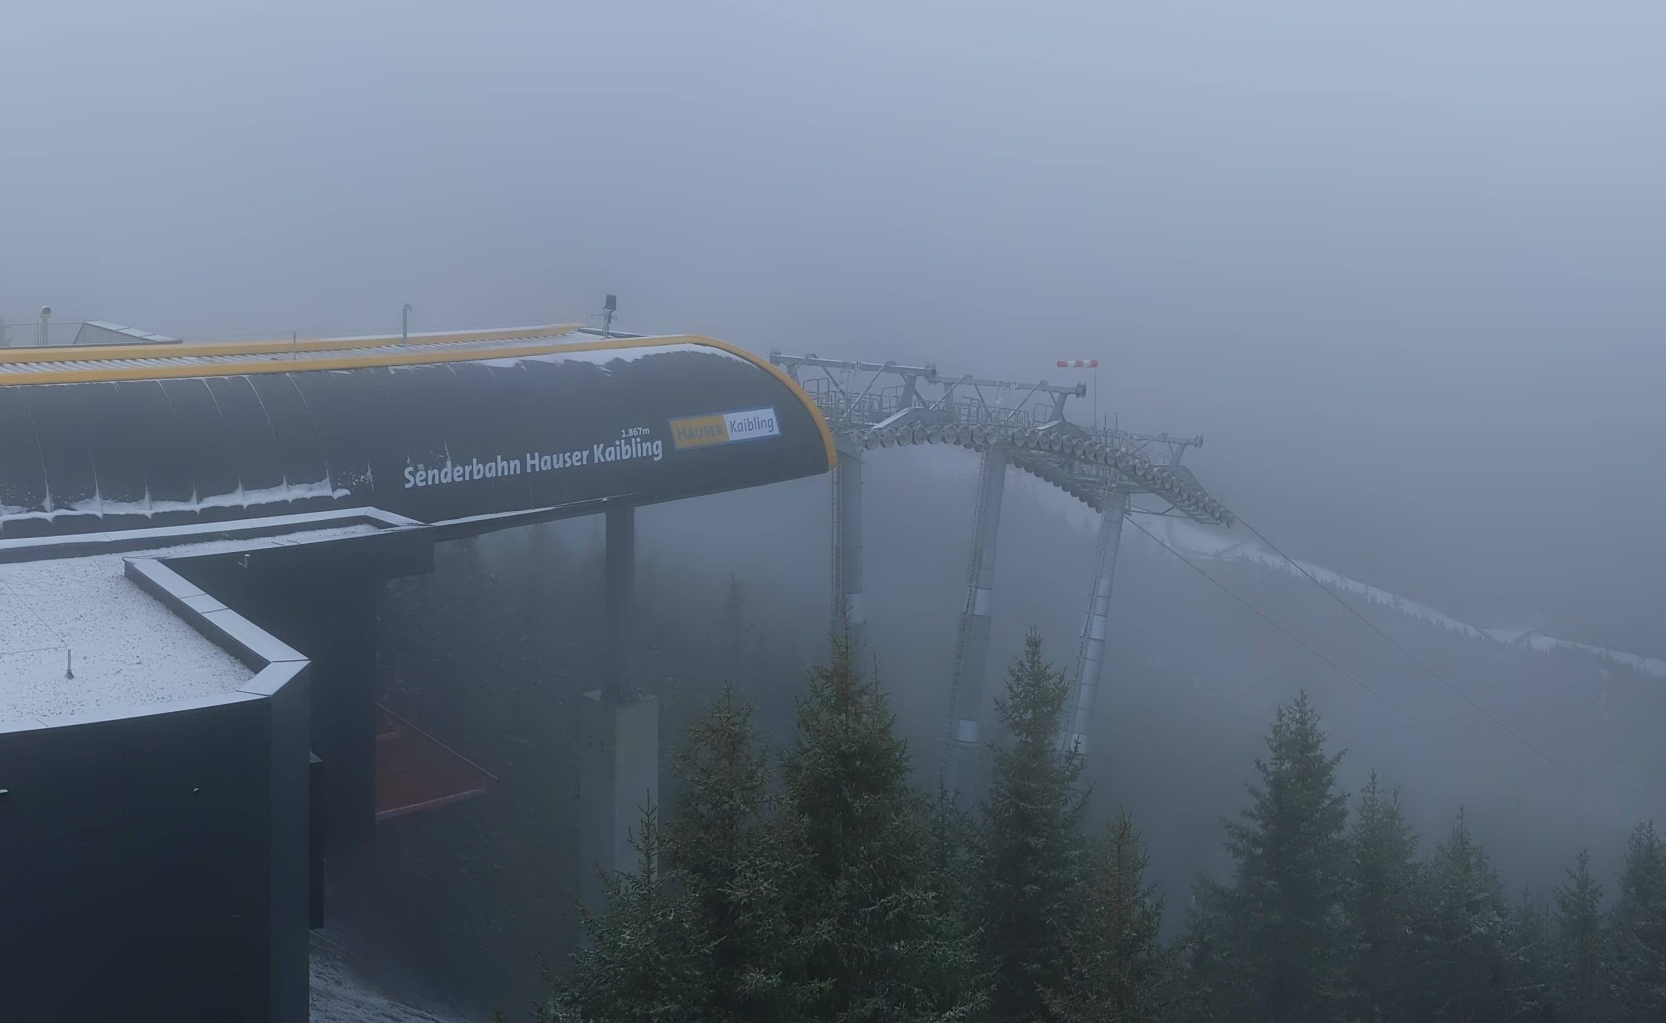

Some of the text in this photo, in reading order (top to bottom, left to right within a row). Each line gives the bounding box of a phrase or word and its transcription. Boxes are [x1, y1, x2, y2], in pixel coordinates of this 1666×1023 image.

[620, 427, 650, 438] 1.867m
[676, 416, 774, 441] HAUSER Kaibling
[403, 437, 663, 489] Senderbahn Hauser Kaibling
